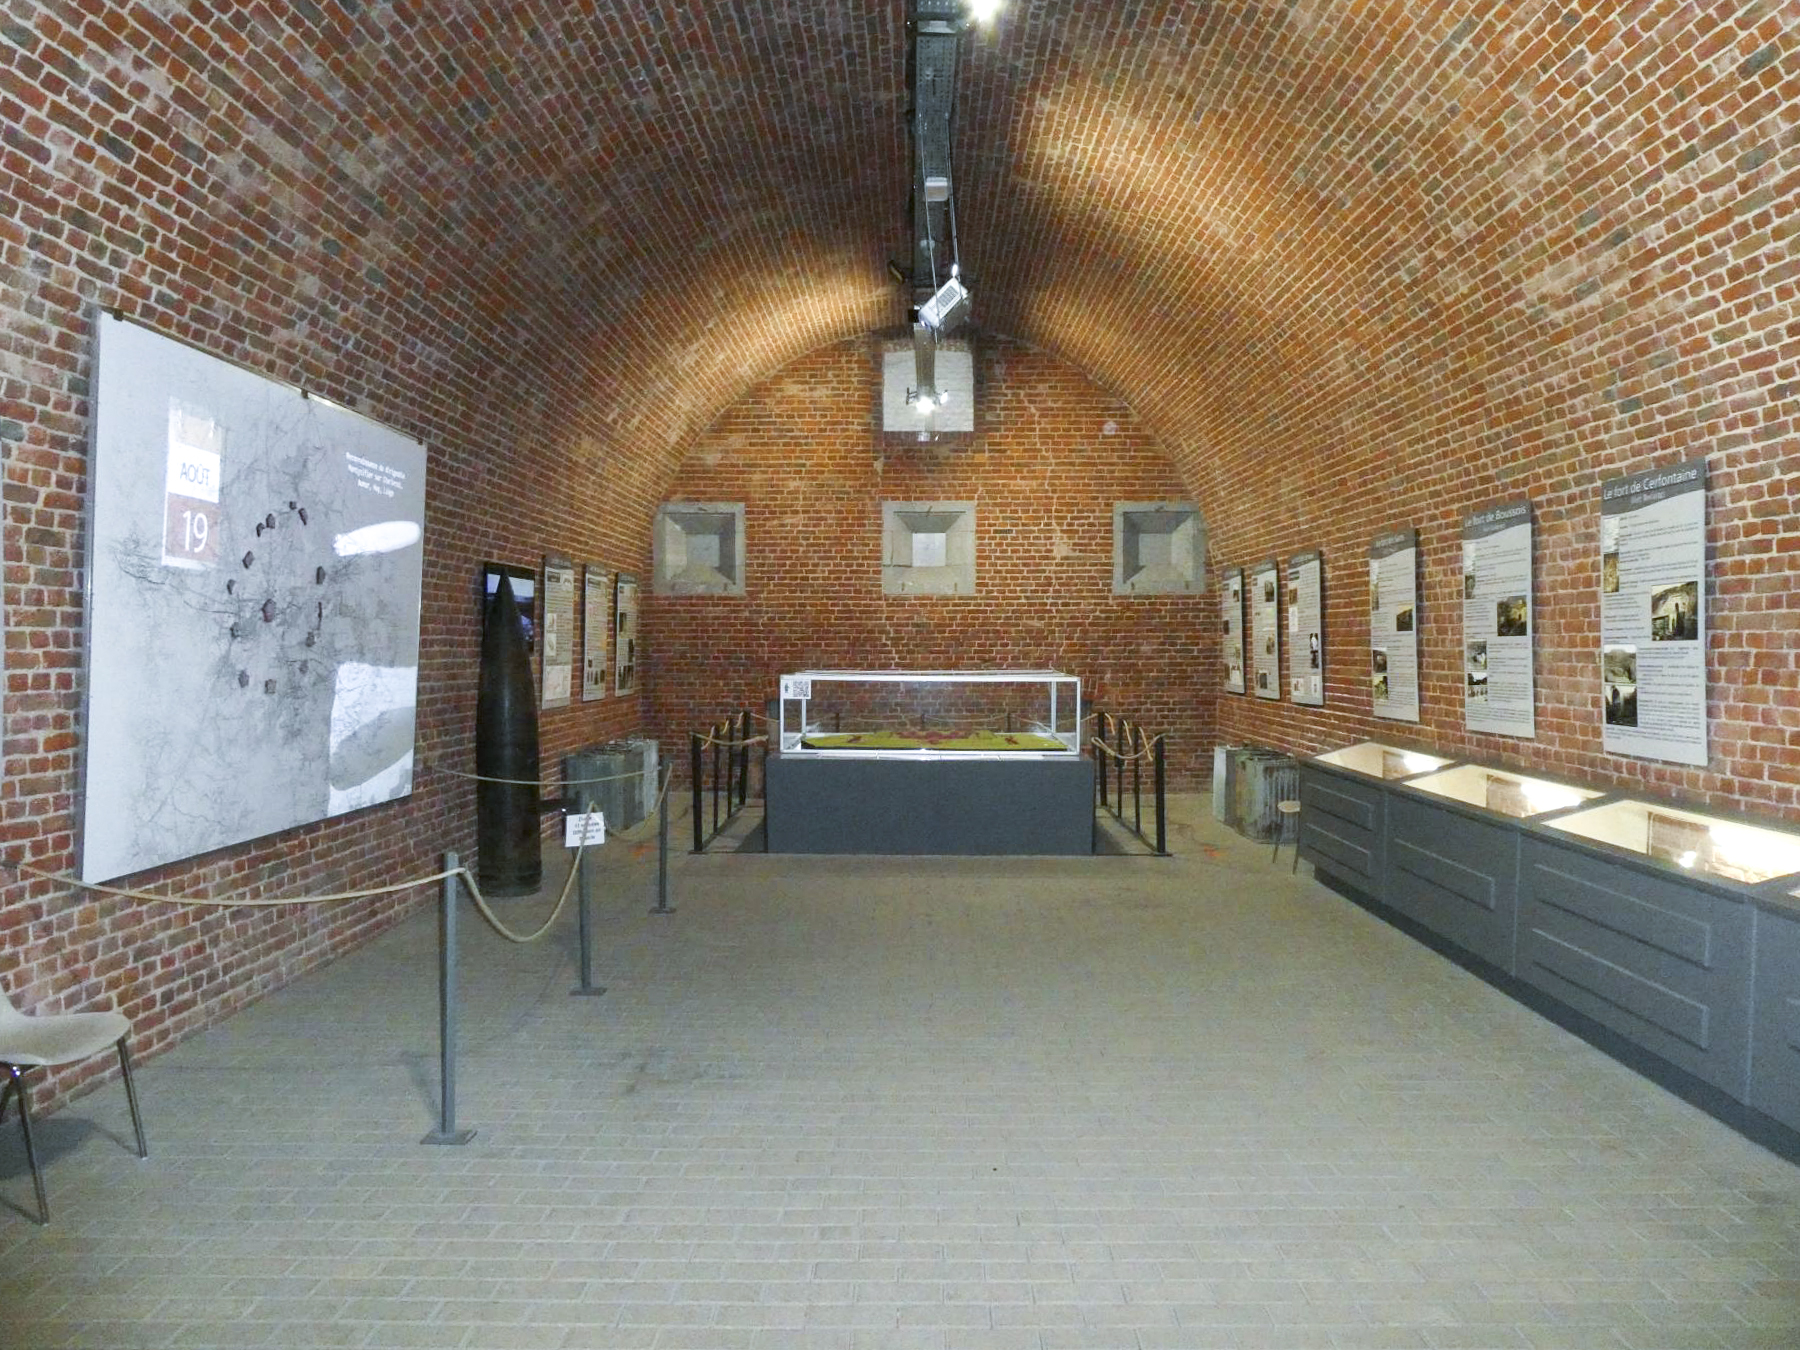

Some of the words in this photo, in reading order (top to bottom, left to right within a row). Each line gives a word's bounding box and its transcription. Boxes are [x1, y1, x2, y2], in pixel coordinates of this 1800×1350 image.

[180, 462, 210, 486] AOÛT
[1603, 488, 1613, 500] Le
[1614, 485, 1629, 497] fort
[1630, 481, 1641, 494] de
[1643, 468, 1697, 490] Cerfontaine
[1496, 506, 1527, 520] Boussois
[183, 510, 209, 554] 19
